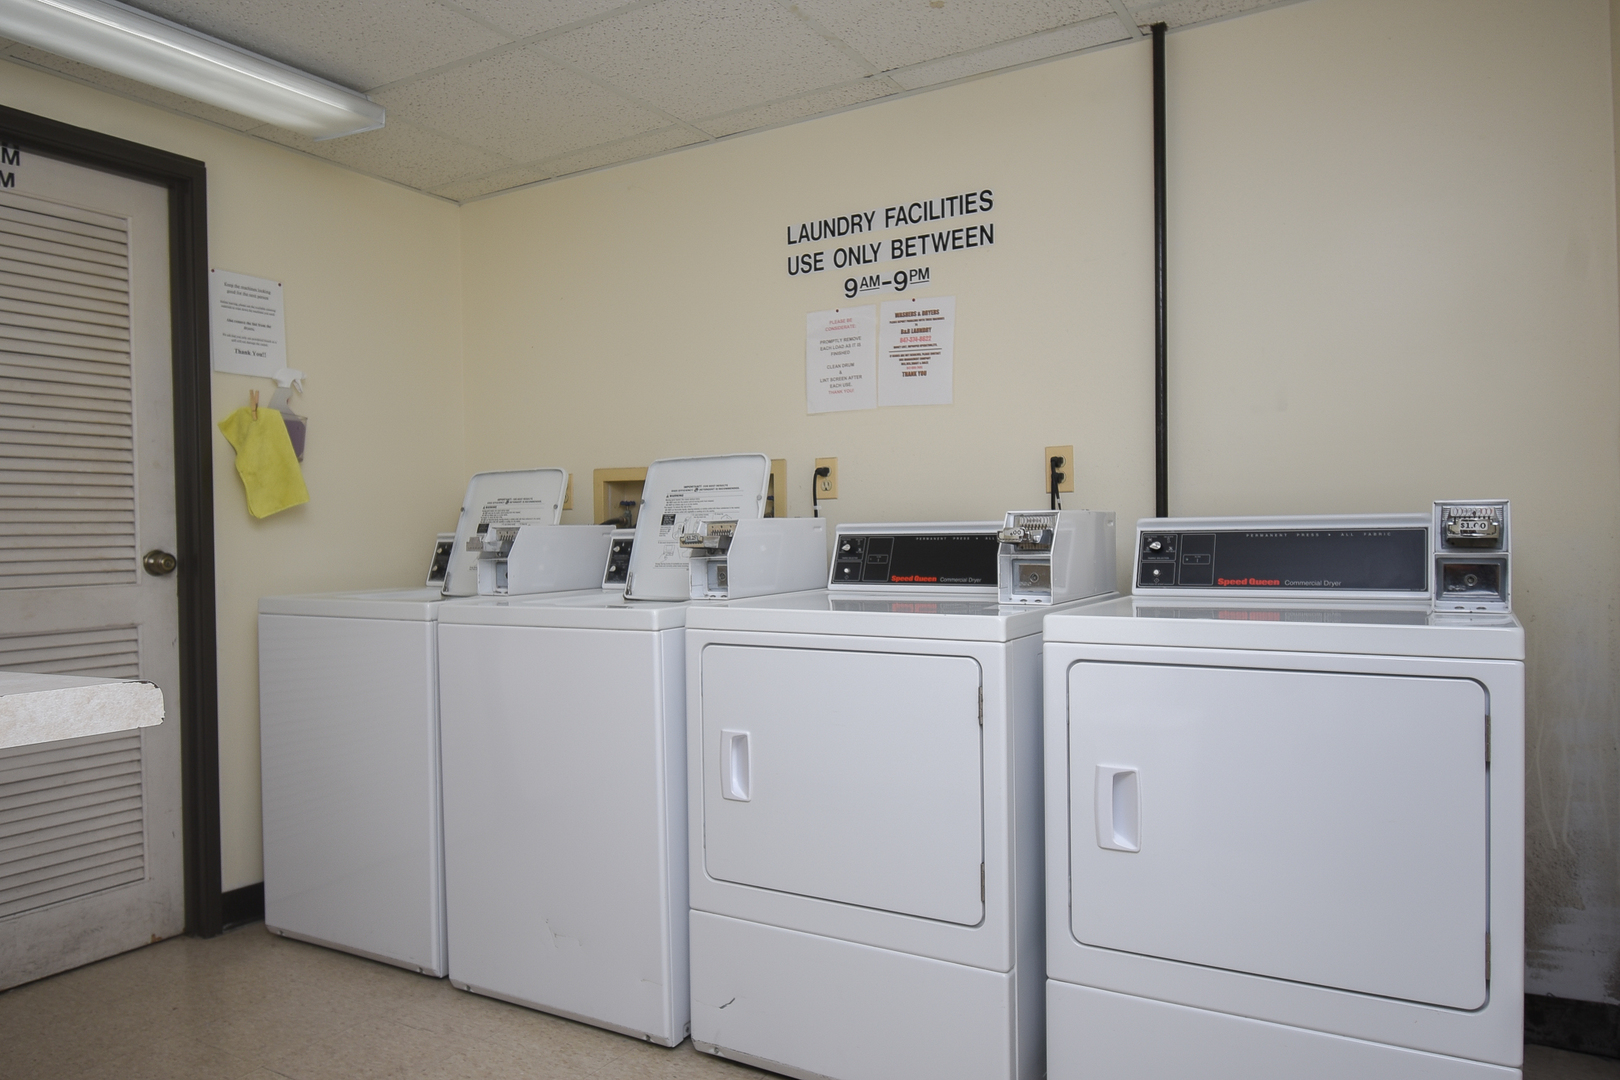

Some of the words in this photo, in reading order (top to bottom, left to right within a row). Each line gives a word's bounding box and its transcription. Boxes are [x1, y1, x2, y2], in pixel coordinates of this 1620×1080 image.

[787, 211, 875, 245] LAUNDRY
[885, 190, 994, 228] FACILITIES
[788, 252, 824, 275] USE
[834, 242, 881, 268] ONLY
[892, 224, 994, 259] BETWEEN
[1217, 578, 1247, 586] Speed
[1249, 578, 1280, 586] Queen
[1324, 580, 1342, 588] Dryer
